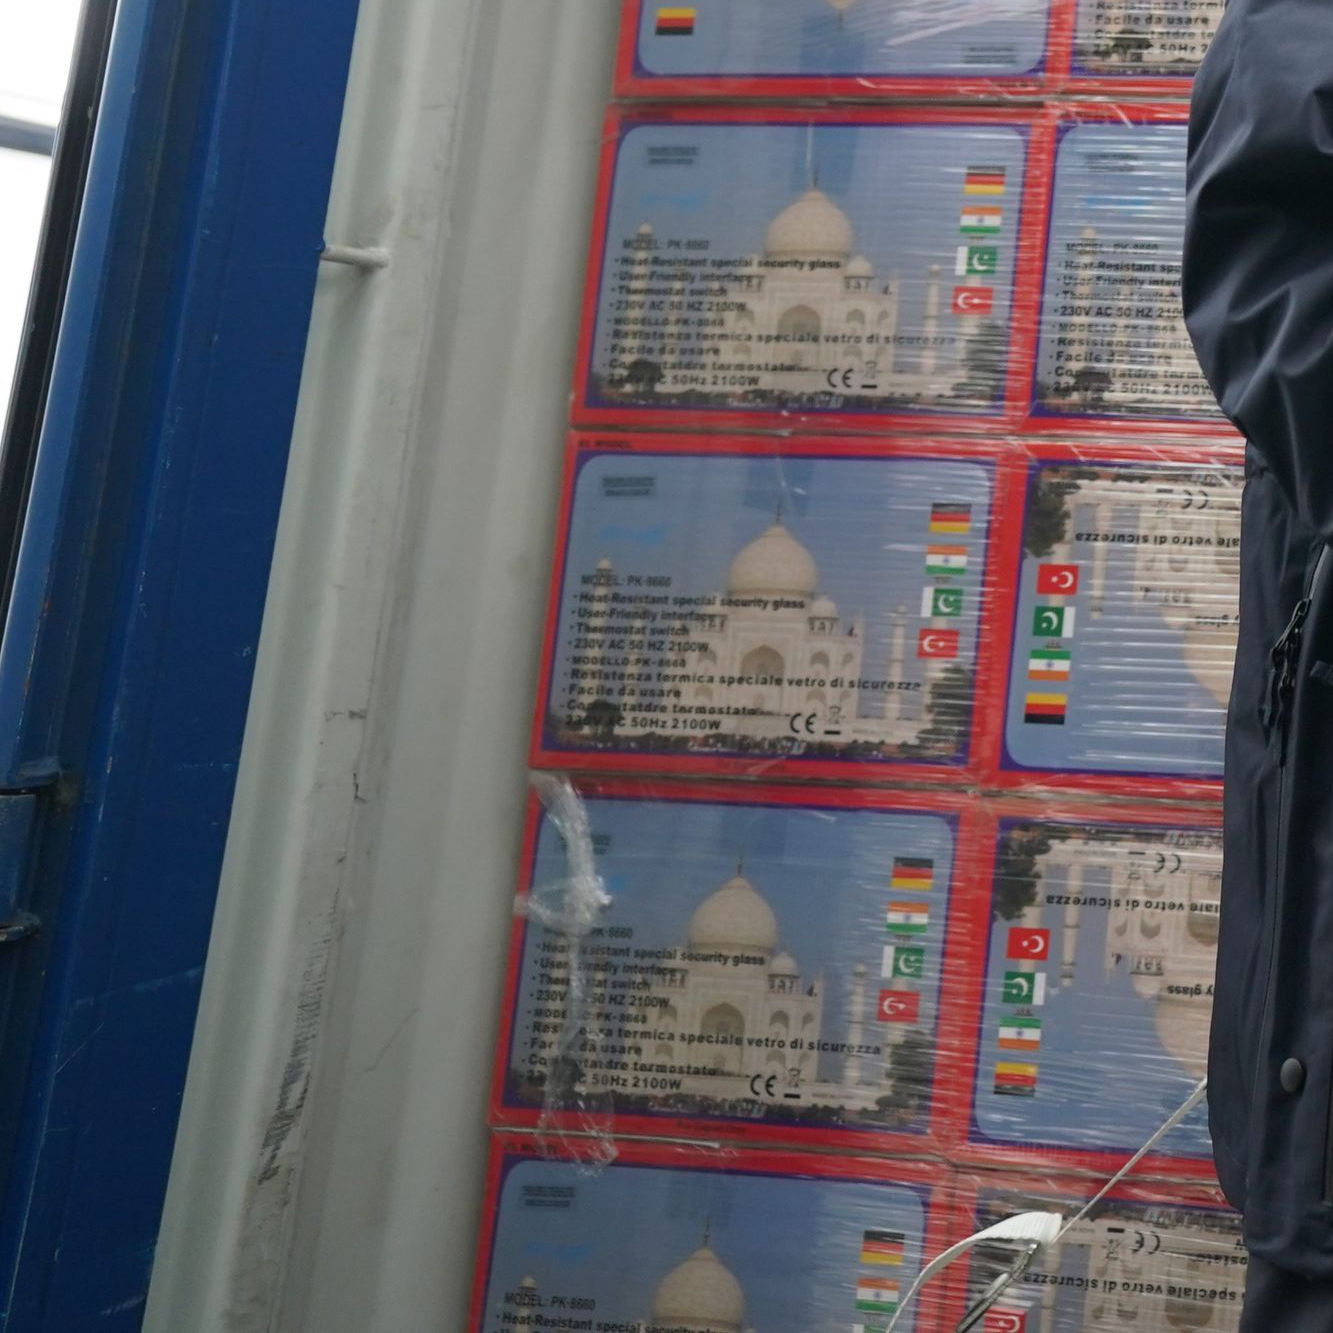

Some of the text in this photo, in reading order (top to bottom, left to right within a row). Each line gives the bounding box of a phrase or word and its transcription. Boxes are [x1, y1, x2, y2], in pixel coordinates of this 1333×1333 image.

[1102, 1278, 1118, 1293] di
[1122, 1281, 1164, 1295] vetro
[1166, 1285, 1237, 1302] speciale
